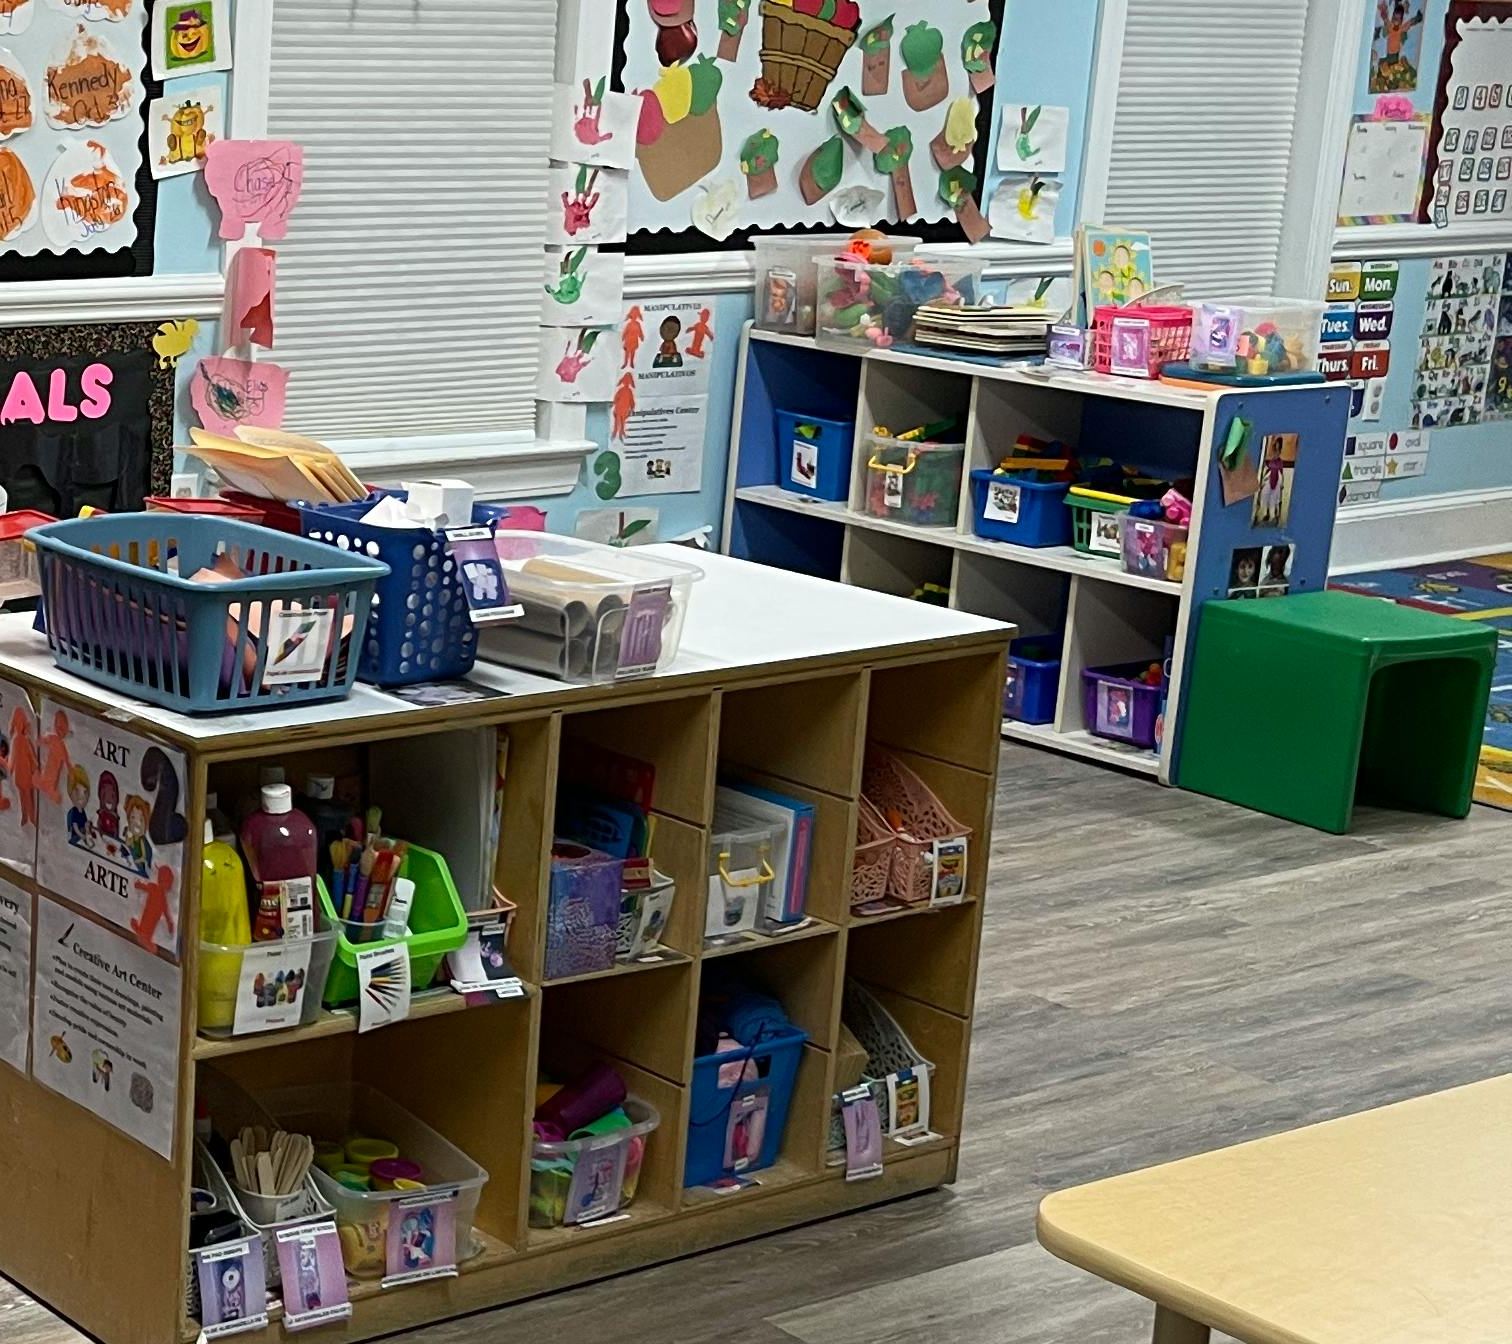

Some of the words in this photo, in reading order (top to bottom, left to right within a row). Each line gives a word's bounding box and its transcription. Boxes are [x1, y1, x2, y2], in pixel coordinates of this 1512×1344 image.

[3, 2, 14, 28] 4
[45, 62, 119, 103] Kennedy
[1477, 87, 1485, 105] 4
[1492, 86, 1501, 104] 5
[73, 95, 106, 125] Oct
[1328, 279, 1352, 293] Sun.
[1364, 277, 1393, 292] Mon.
[1321, 318, 1350, 333] Tues.
[1358, 316, 1388, 333] Wed.
[1317, 356, 1349, 373] Thurs.
[1361, 355, 1379, 372] Fri.
[1498, 376, 1507, 393] 9
[93, 737, 130, 768] ART
[140, 745, 187, 846] 2
[84, 860, 129, 899] ARTE
[72, 942, 111, 973] Creative
[112, 964, 128, 982] Art
[129, 973, 163, 1001] Center
